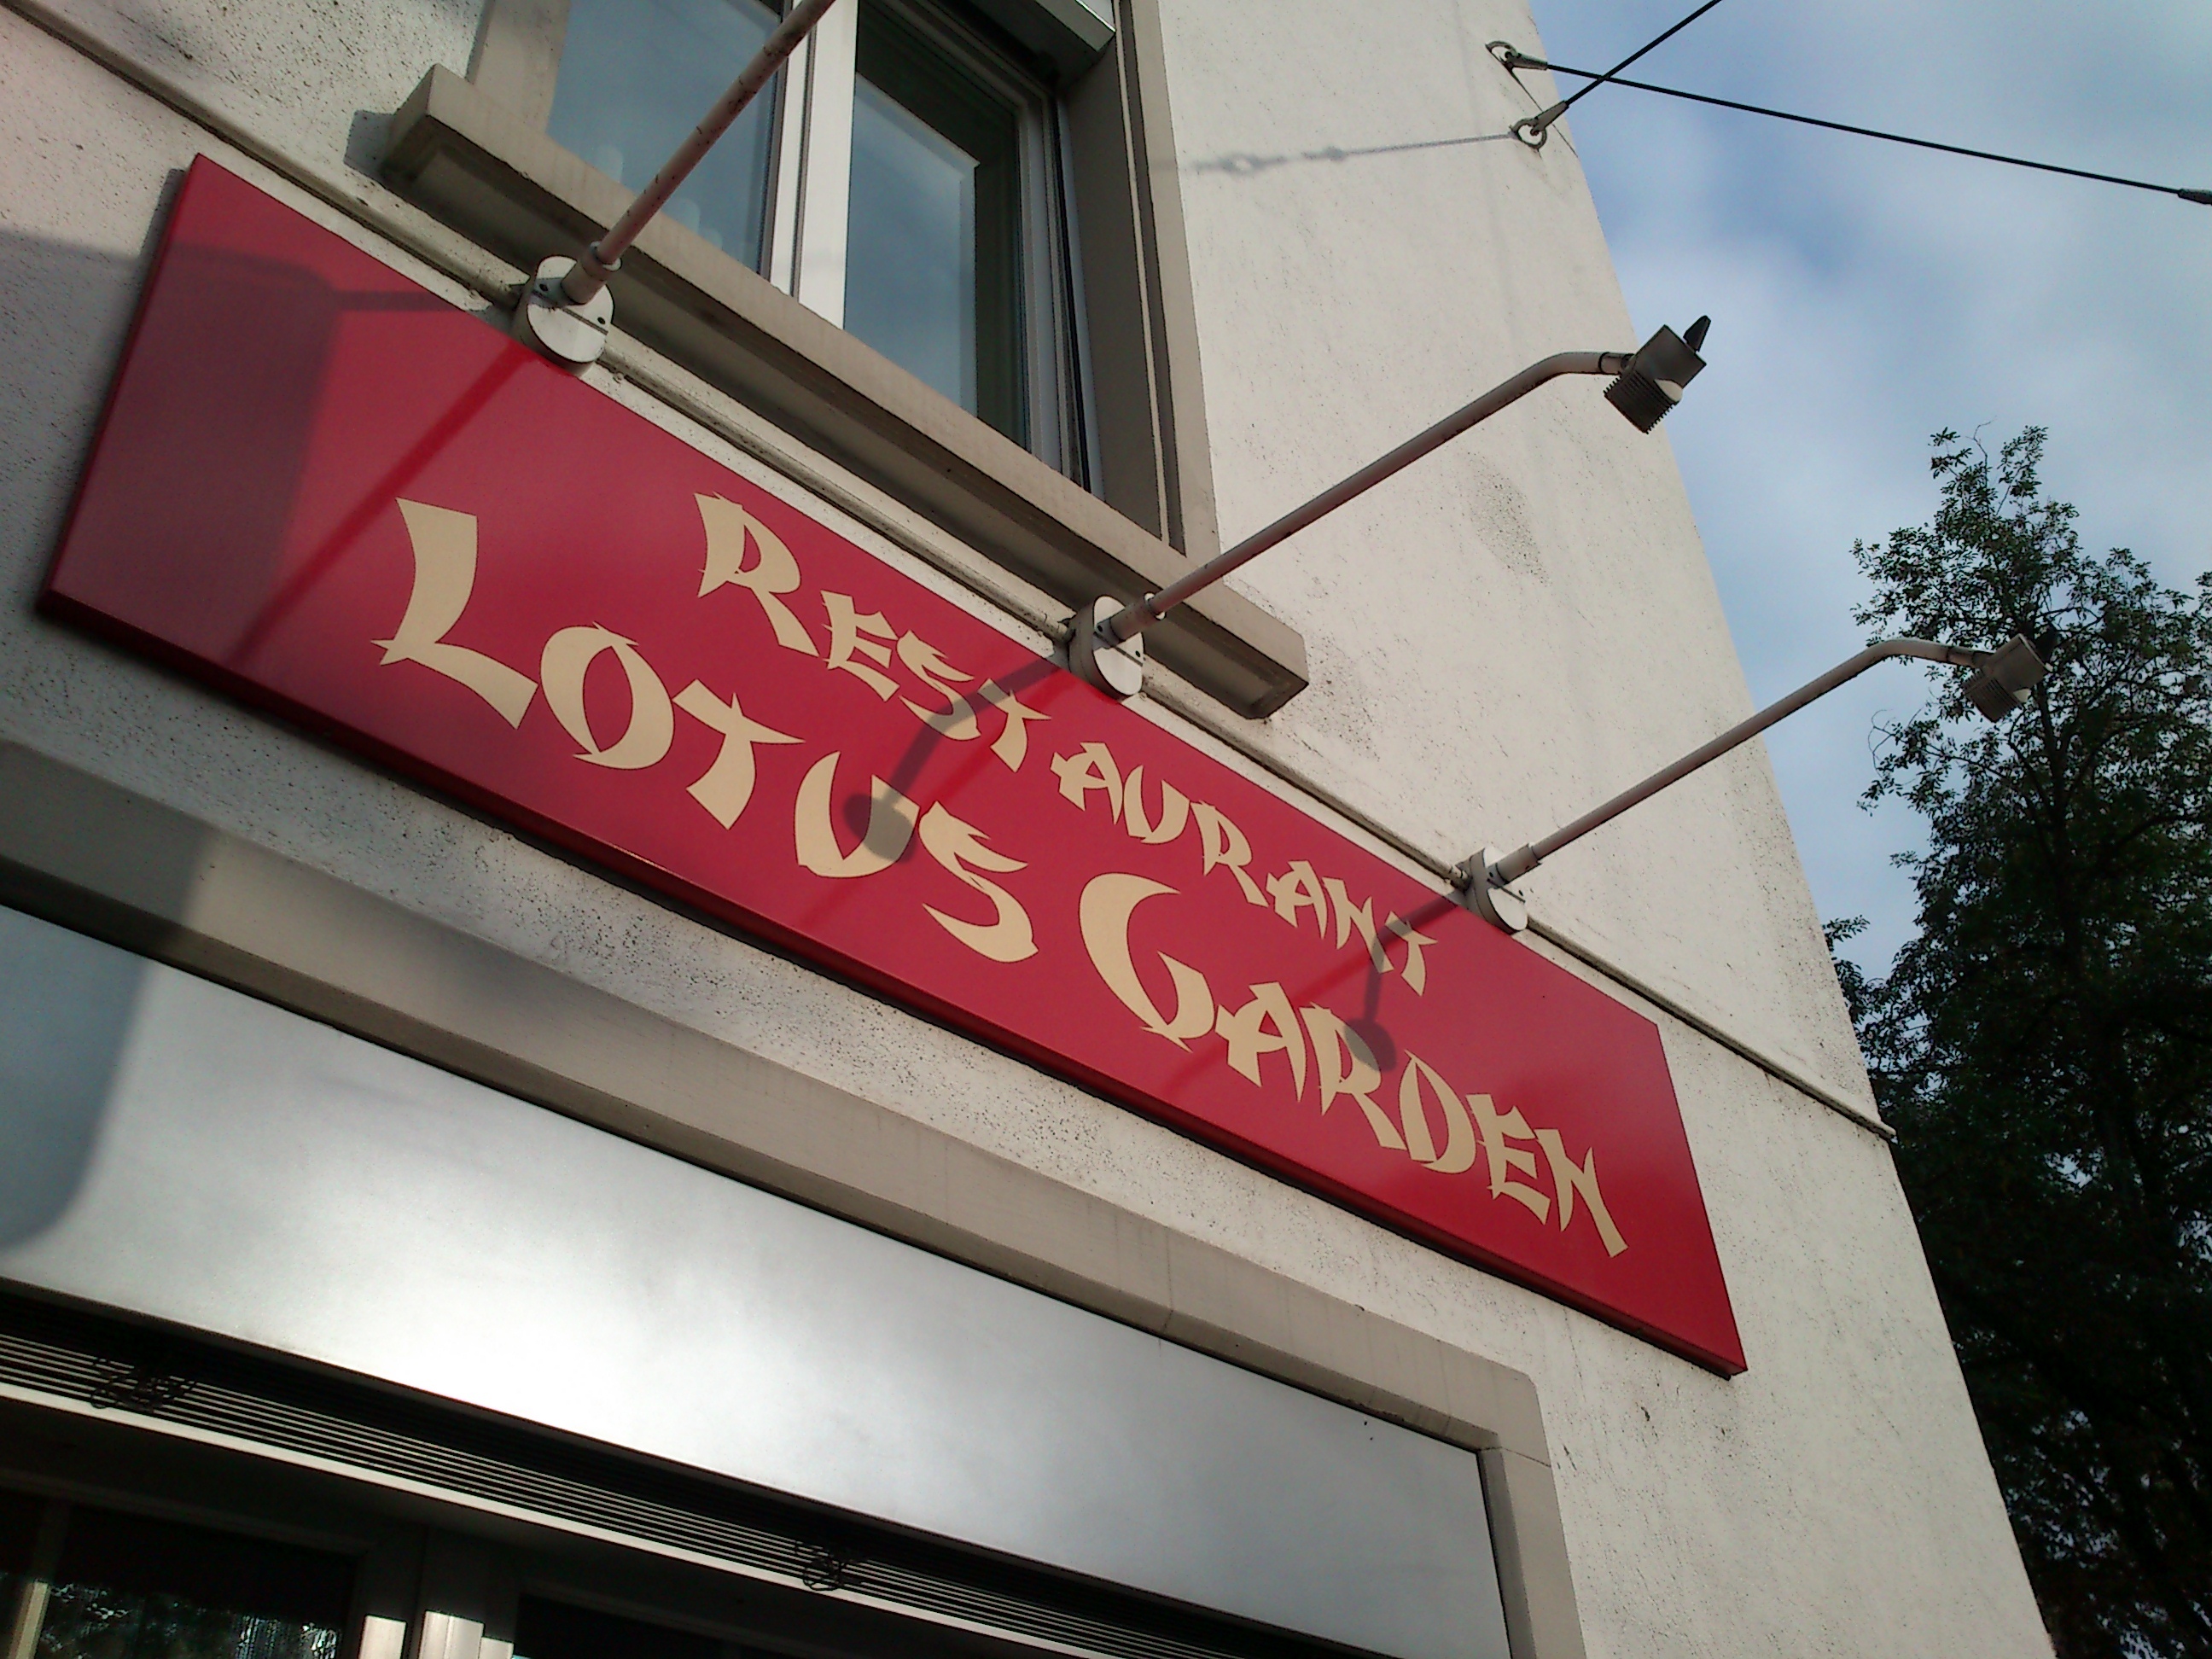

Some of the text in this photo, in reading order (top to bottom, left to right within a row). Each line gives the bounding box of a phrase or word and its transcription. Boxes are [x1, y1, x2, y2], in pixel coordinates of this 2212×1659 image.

[371, 498, 1628, 1258] LOTUS GARDEN
[693, 492, 1438, 997] RESTAURANT
